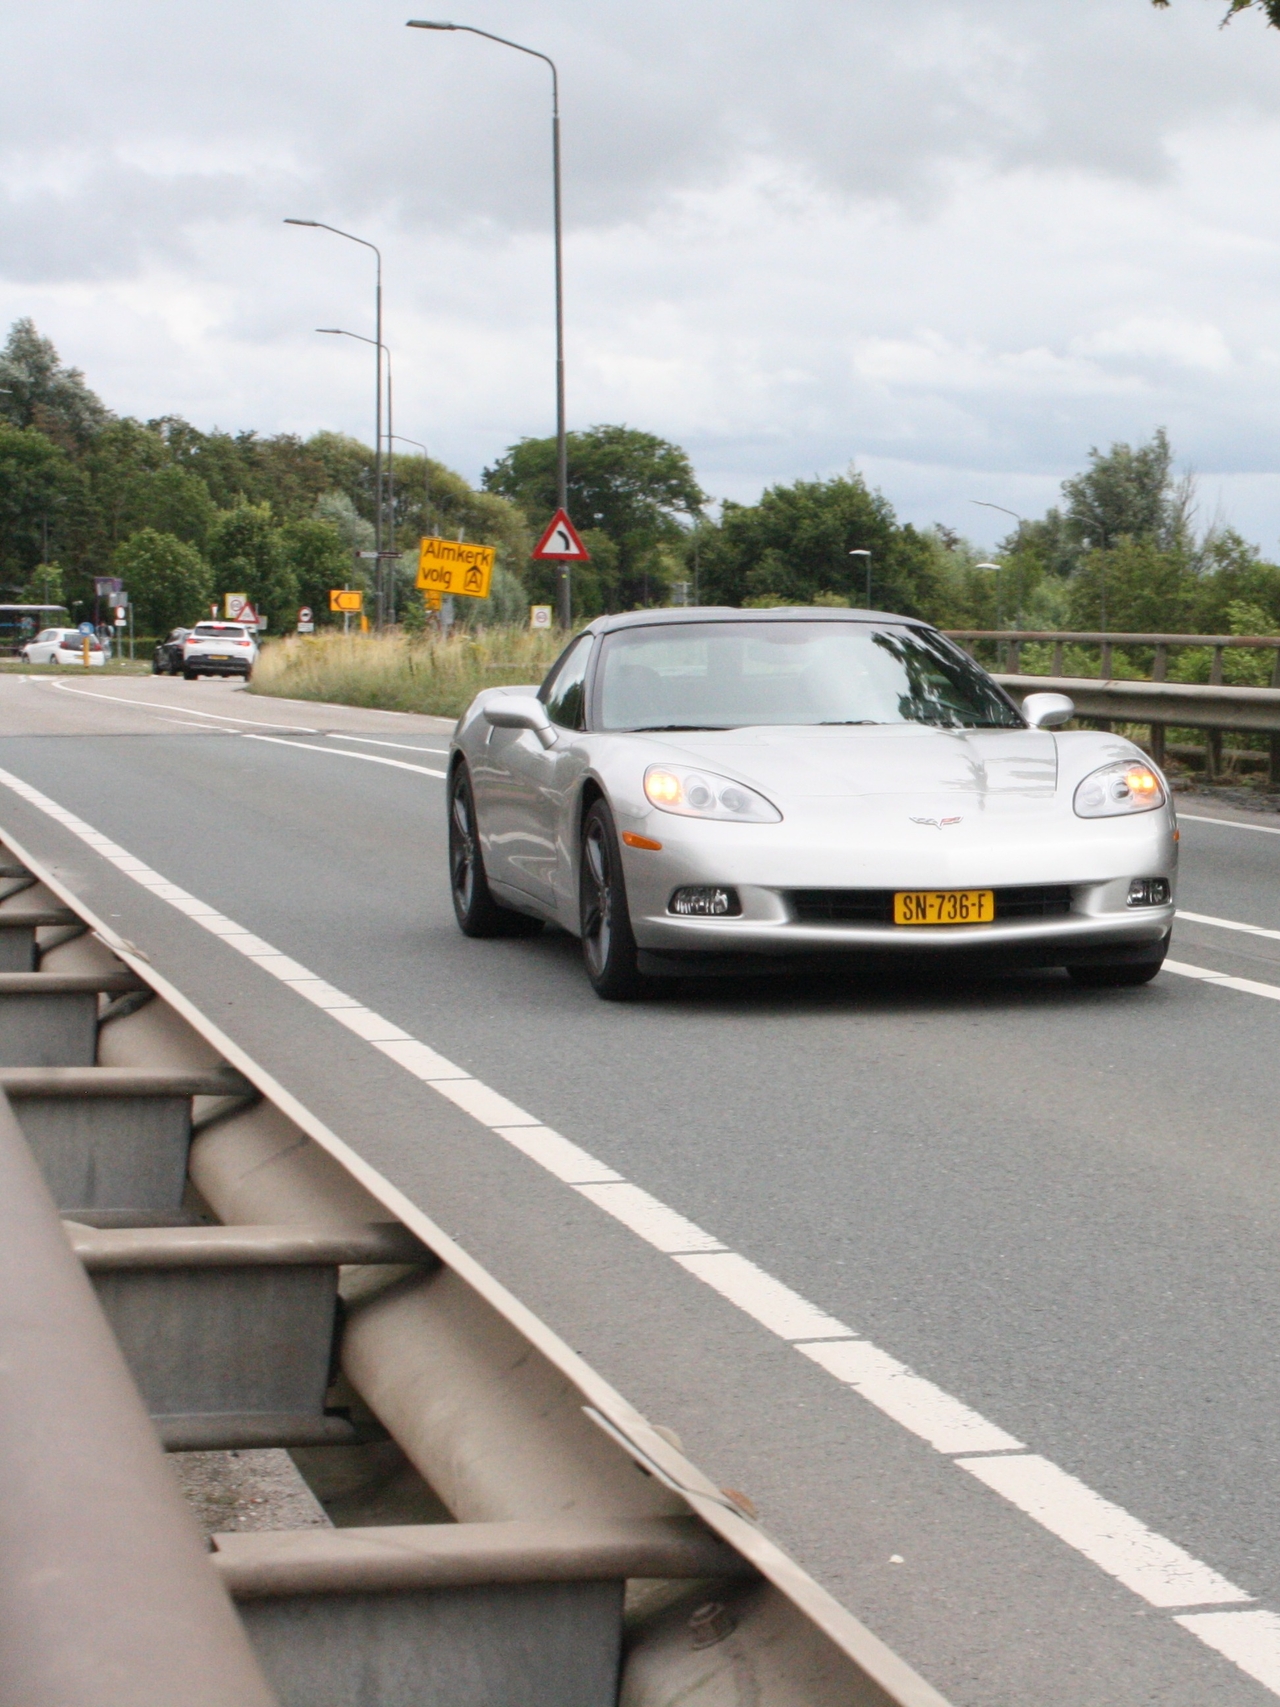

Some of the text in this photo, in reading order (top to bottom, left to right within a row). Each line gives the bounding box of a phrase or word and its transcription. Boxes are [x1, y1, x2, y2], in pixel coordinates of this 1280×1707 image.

[423, 541, 490, 567] Almkerk
[422, 566, 452, 589] volg
[903, 893, 986, 920] SN-736-F
